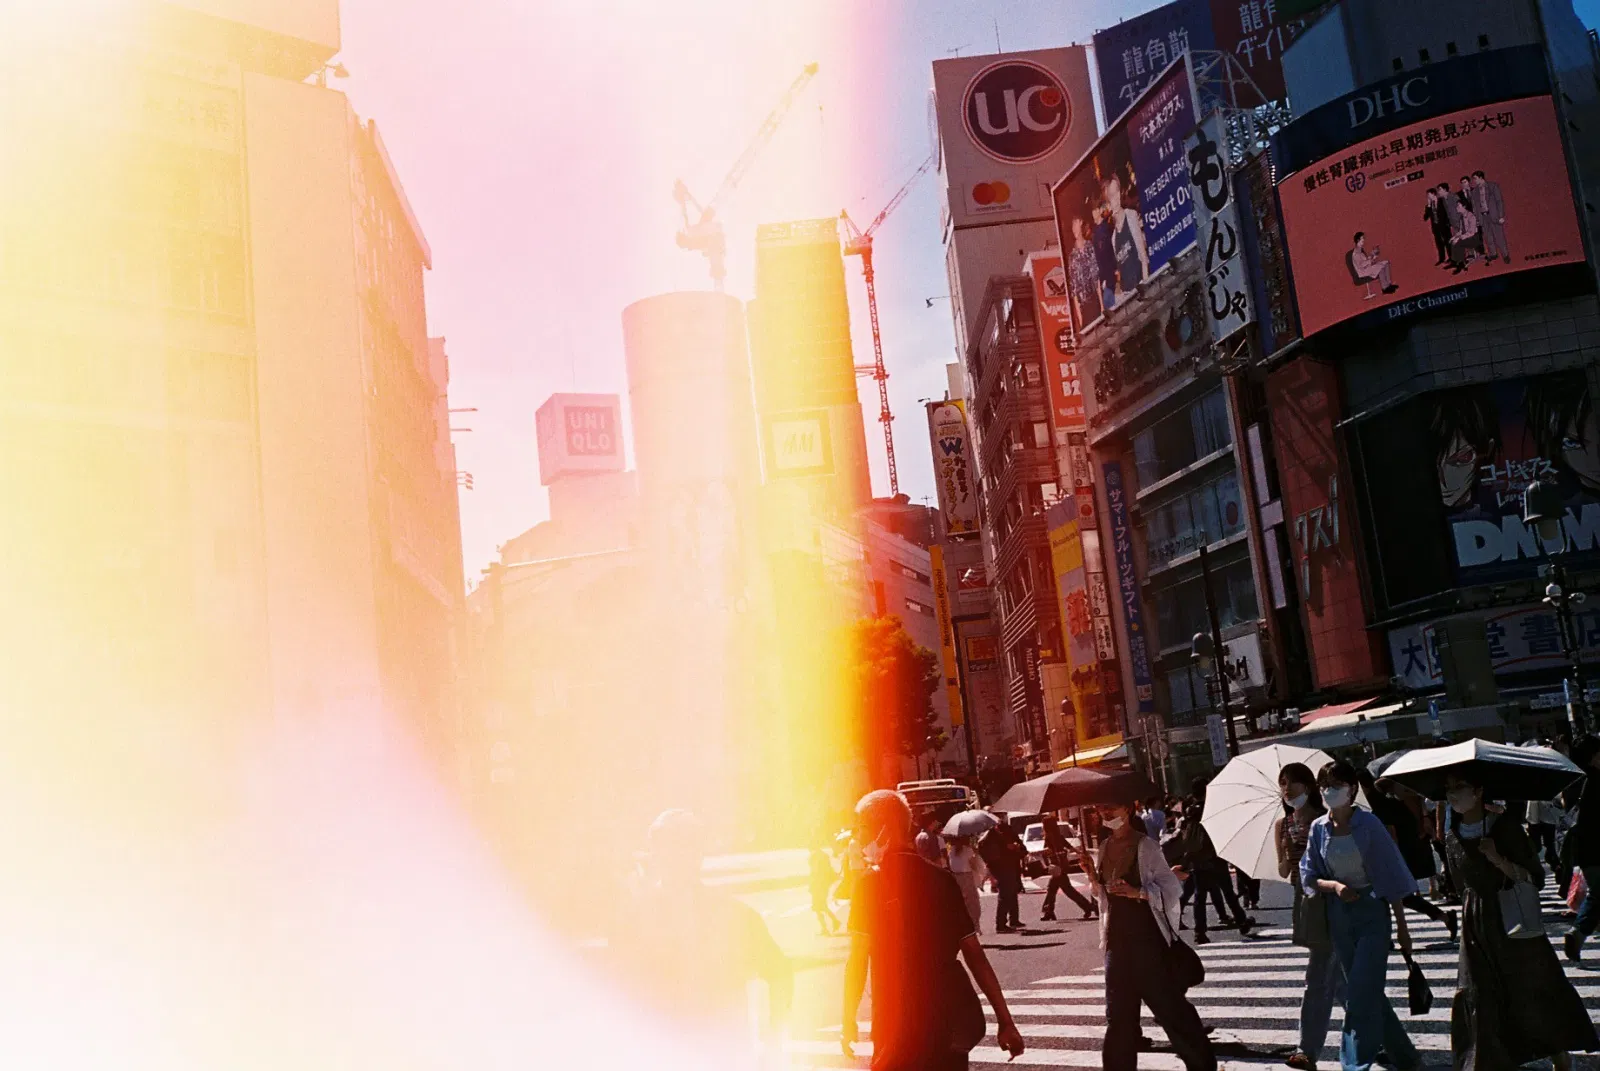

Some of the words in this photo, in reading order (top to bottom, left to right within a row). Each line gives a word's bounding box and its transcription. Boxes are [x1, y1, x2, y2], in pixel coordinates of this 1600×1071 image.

[1122, 26, 1189, 79] 龍角散
[974, 85, 1061, 136] UC
[1344, 76, 1431, 128] DHC
[1303, 111, 1515, 193] 慢性腎臓病は早期発見が大切
[1144, 182, 1158, 202] THE
[1155, 167, 1173, 193] BEAT
[1188, 125, 1247, 322] もんじゃ
[1388, 302, 1416, 319] DHC
[1417, 288, 1468, 310] Channel
[1060, 362, 1077, 378] B1
[1062, 379, 1082, 397] B2
[569, 411, 605, 429] UNI
[573, 433, 609, 452] QLO
[1109, 488, 1139, 619] サマーフルーツギフト
[1401, 611, 1600, 677] 大堂書店
